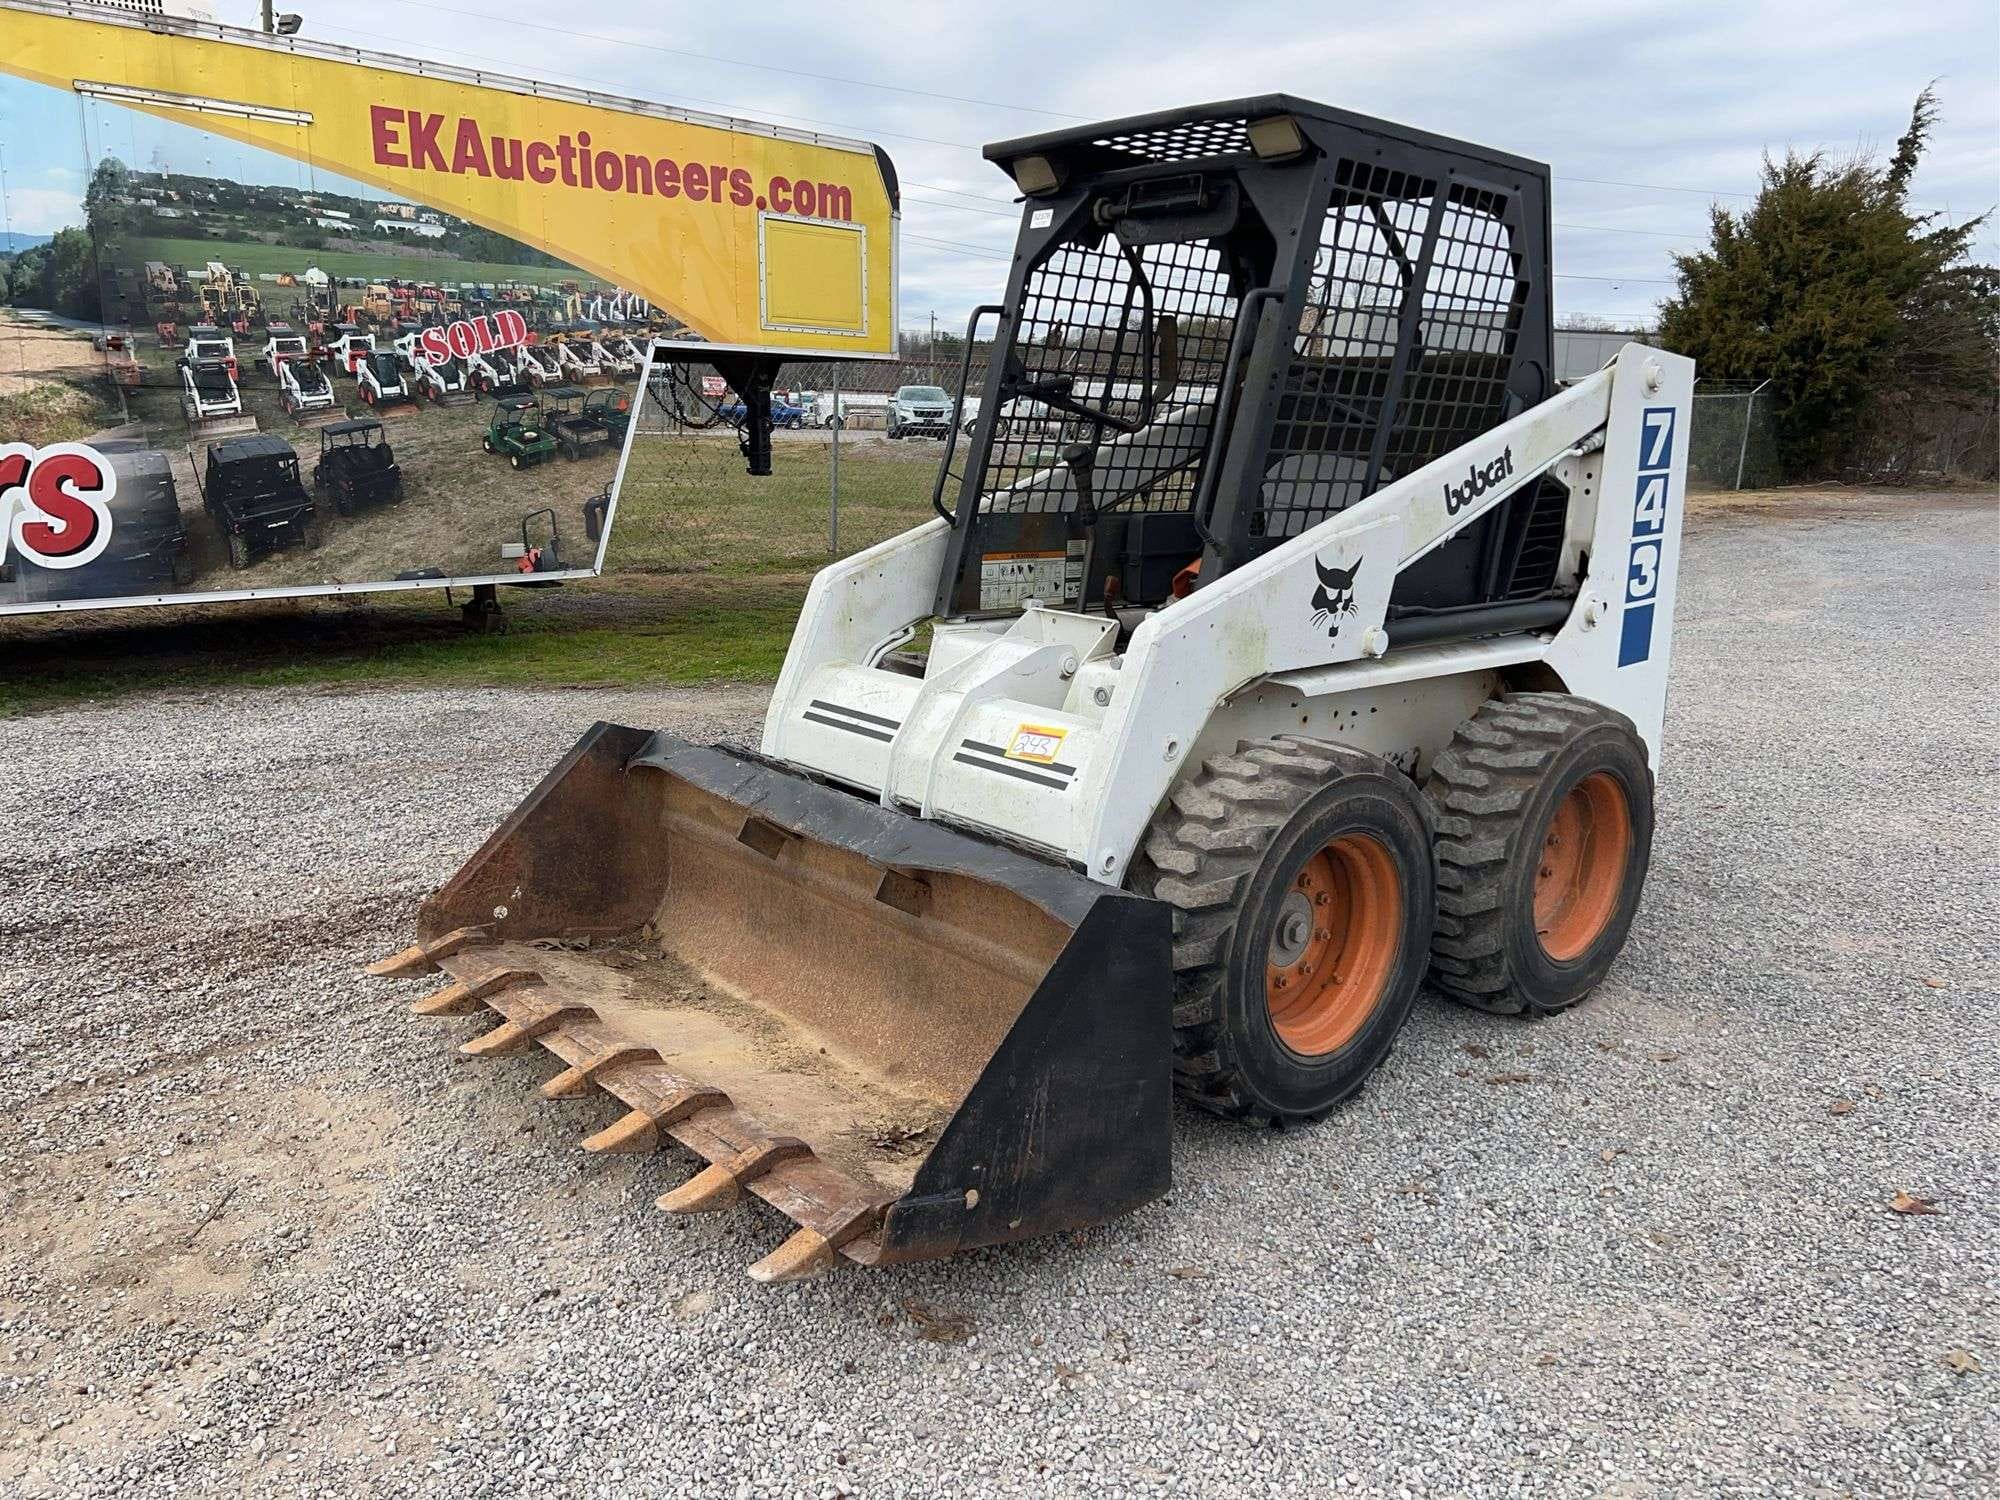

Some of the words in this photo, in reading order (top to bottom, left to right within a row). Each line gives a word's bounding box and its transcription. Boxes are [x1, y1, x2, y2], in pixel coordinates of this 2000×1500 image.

[370, 104, 852, 221] EKAuctioneers.com
[420, 309, 527, 367] SOLD
[1443, 444, 1514, 516] bobcat
[1628, 411, 1673, 598] 743
[1013, 735, 1051, 755] 243
